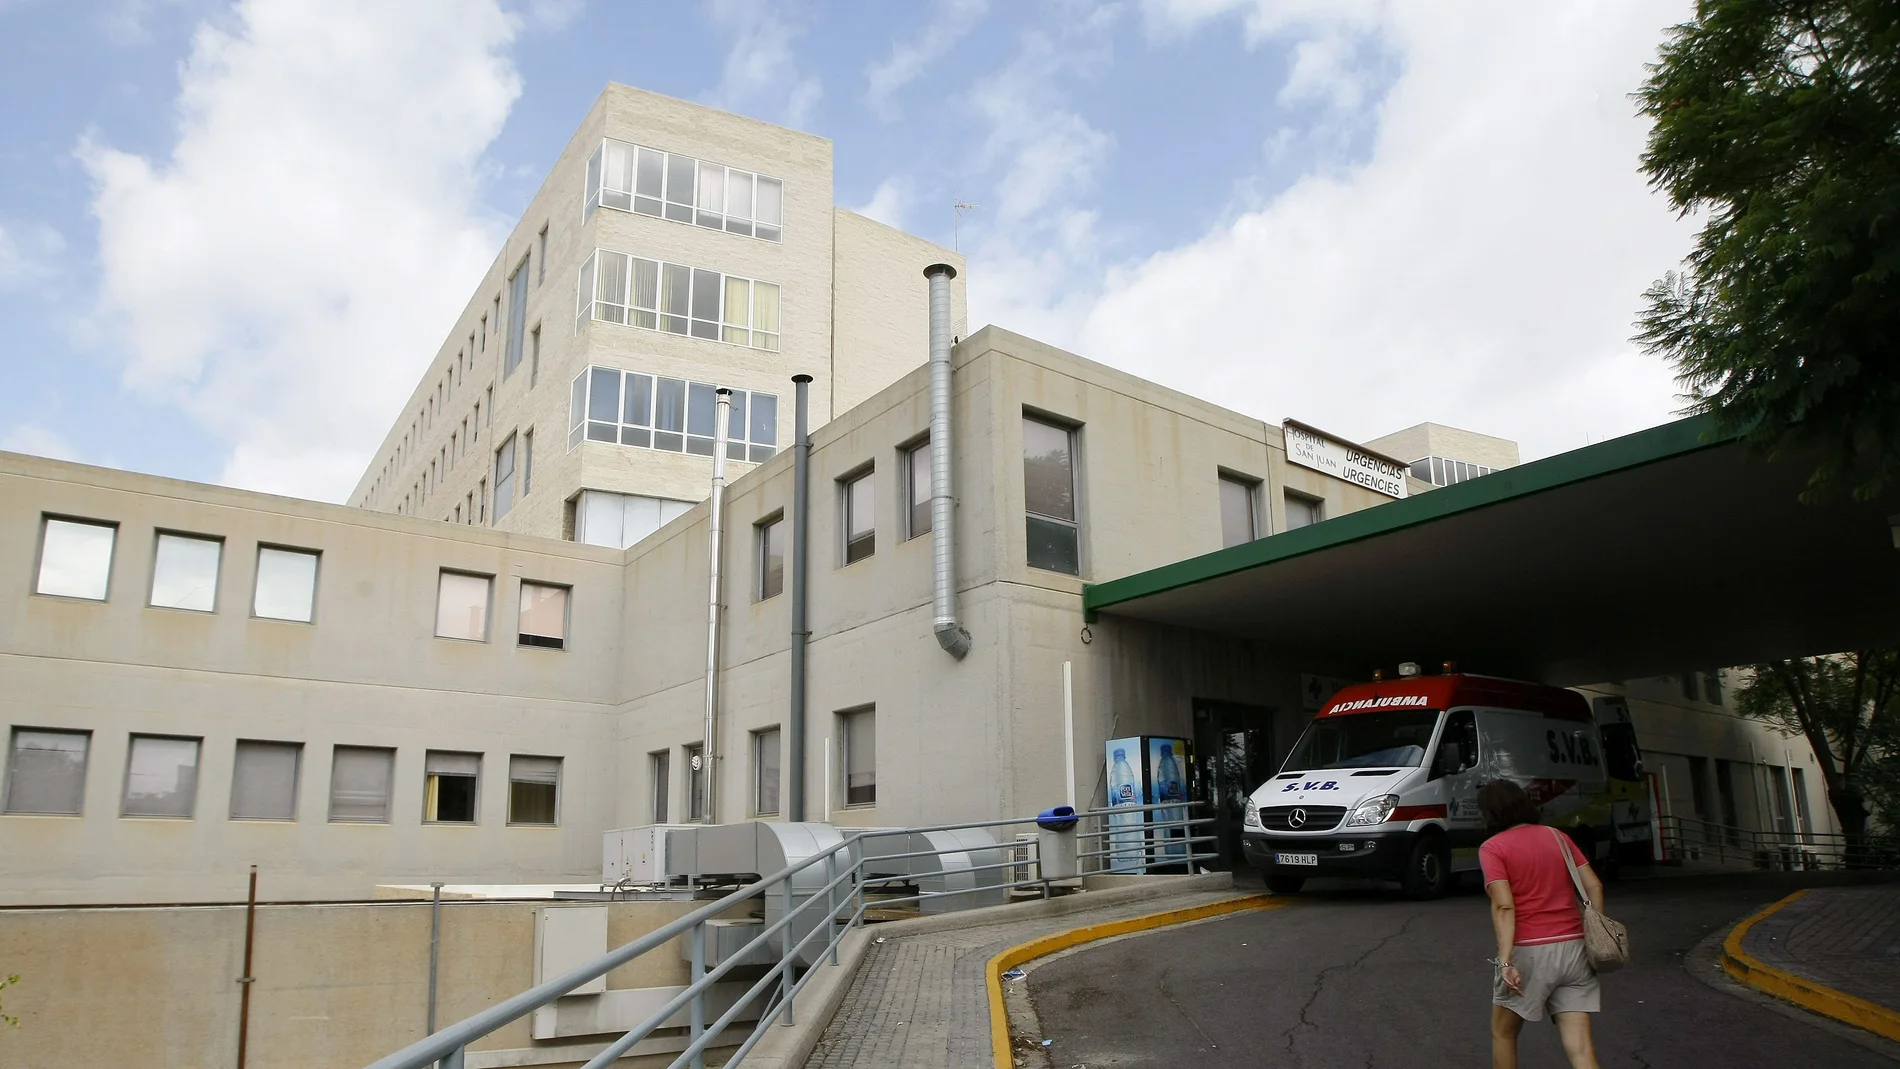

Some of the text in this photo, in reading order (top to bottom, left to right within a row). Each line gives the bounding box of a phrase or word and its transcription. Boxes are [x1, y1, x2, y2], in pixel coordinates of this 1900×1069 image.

[1286, 427, 1325, 448] HOSPITAL
[1305, 443, 1313, 451] DE
[1316, 454, 1336, 468] JUAN
[1346, 449, 1402, 480] URGENCIAS
[1343, 466, 1400, 496] URGENCIES
[1547, 730, 1598, 767] S.V.B.
[1281, 781, 1340, 792] S.V.B.
[1280, 854, 1316, 865] 7619 HLP
